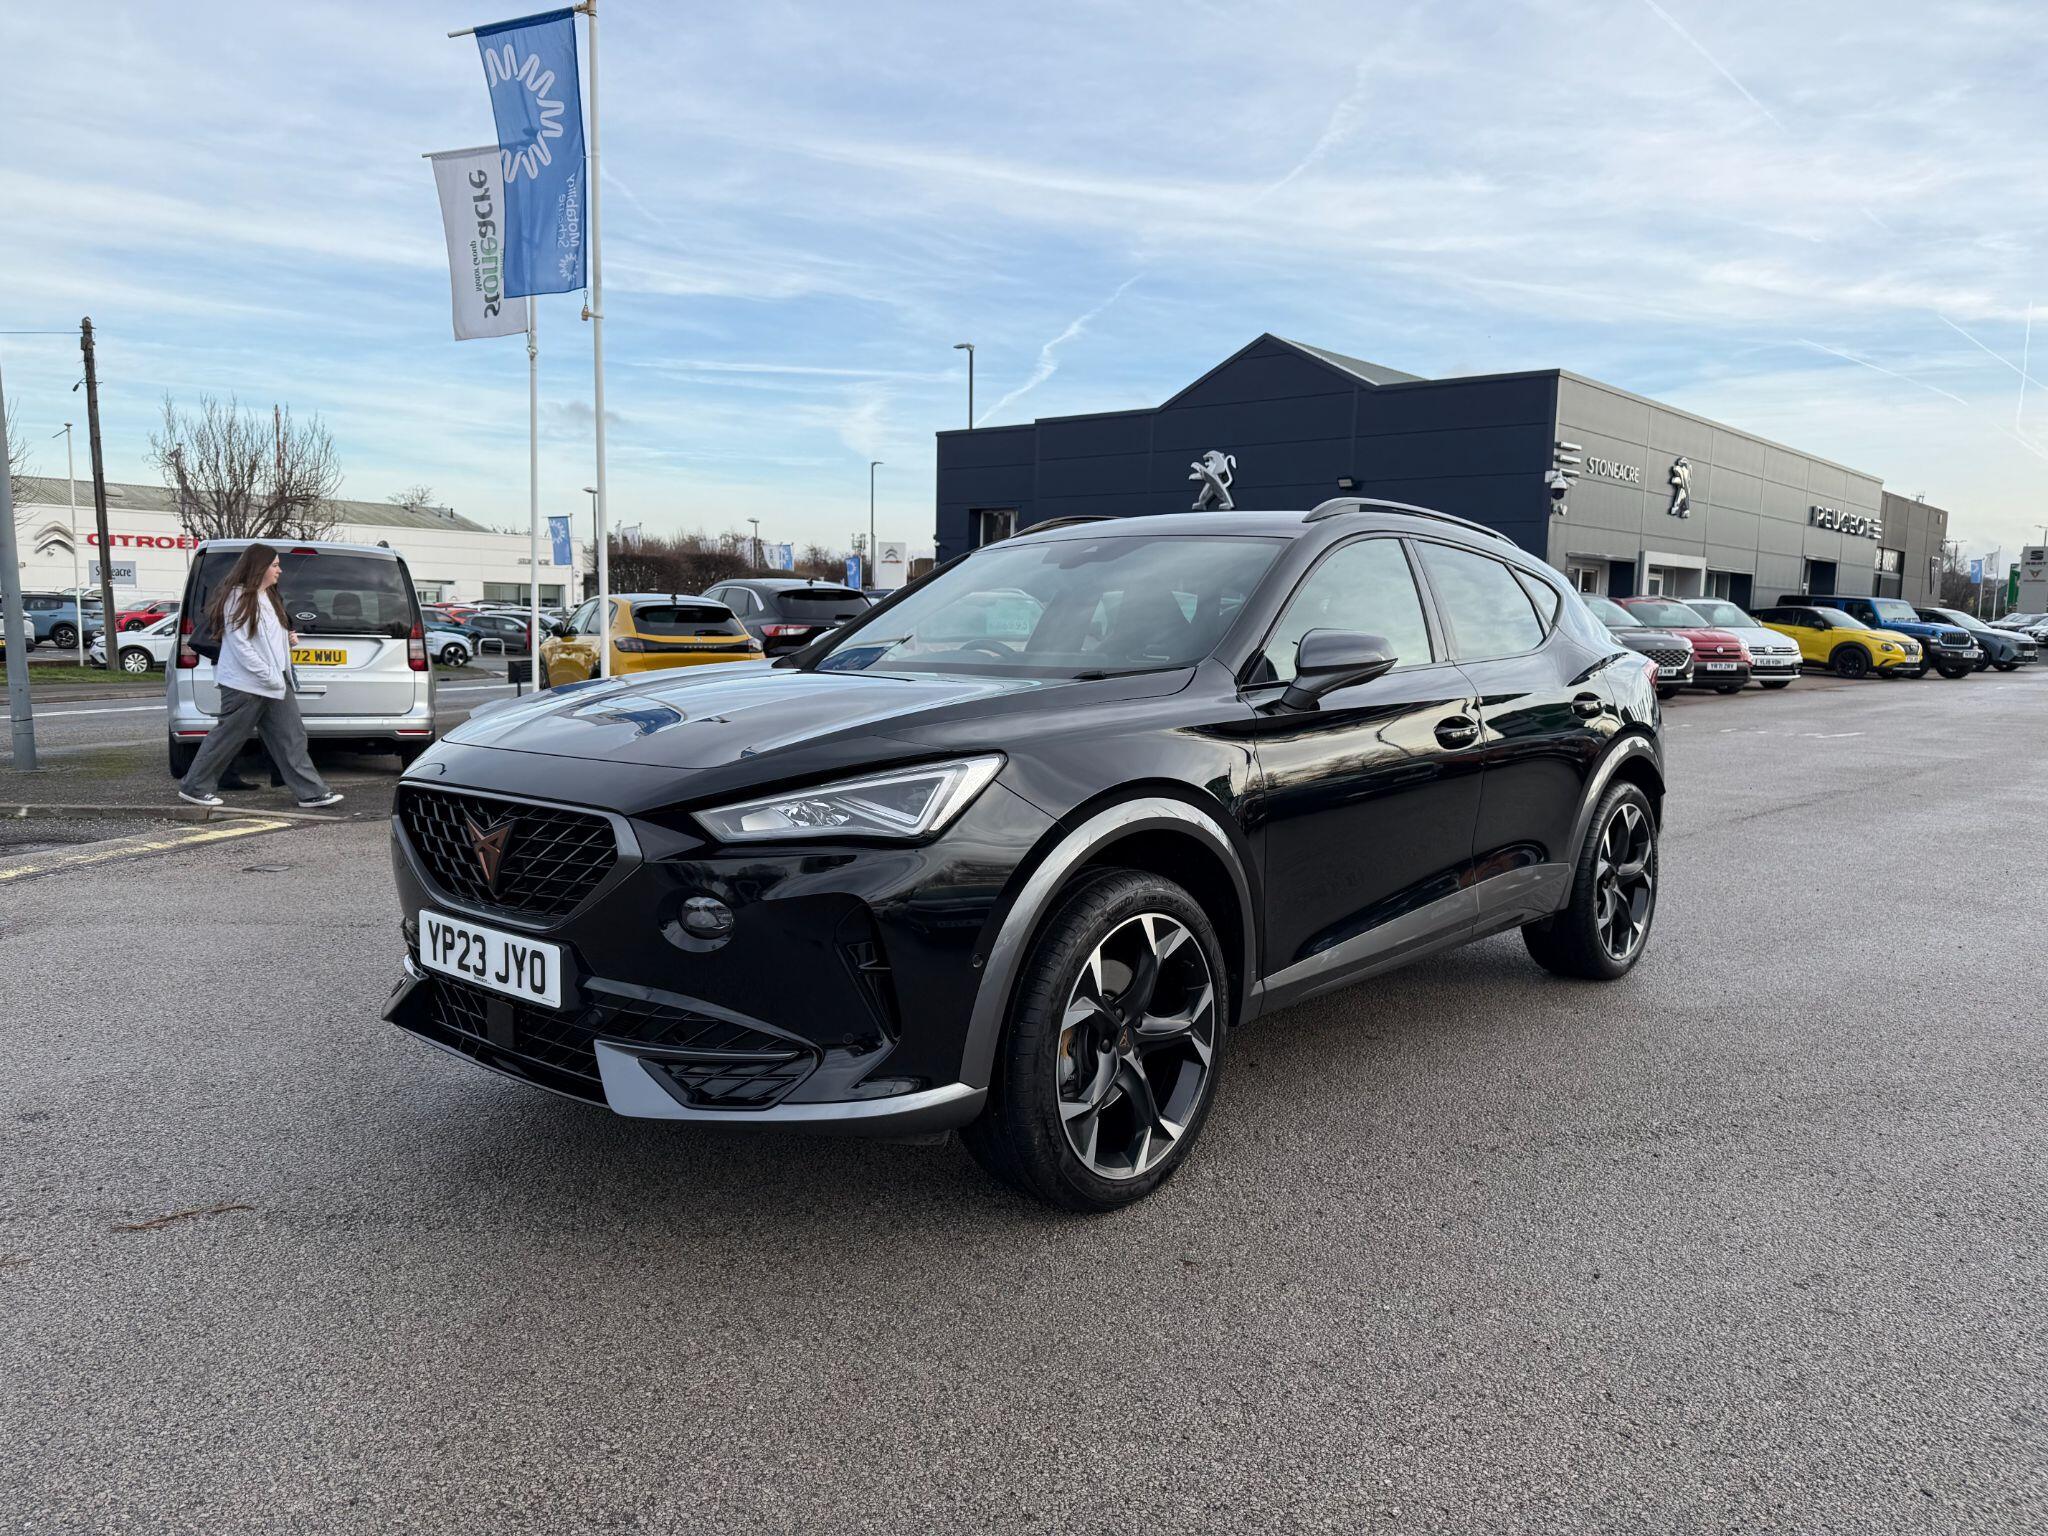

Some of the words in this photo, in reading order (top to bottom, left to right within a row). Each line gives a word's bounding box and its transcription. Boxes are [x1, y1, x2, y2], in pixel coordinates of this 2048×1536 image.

[1586, 457, 1640, 483] STONEACRE
[1814, 505, 1872, 537] PEUGEOT
[86, 533, 199, 550] CITROË
[95, 565, 132, 577] Seacre
[314, 650, 342, 663] WWU
[428, 920, 487, 978] YP23
[495, 942, 546, 995] JYO
